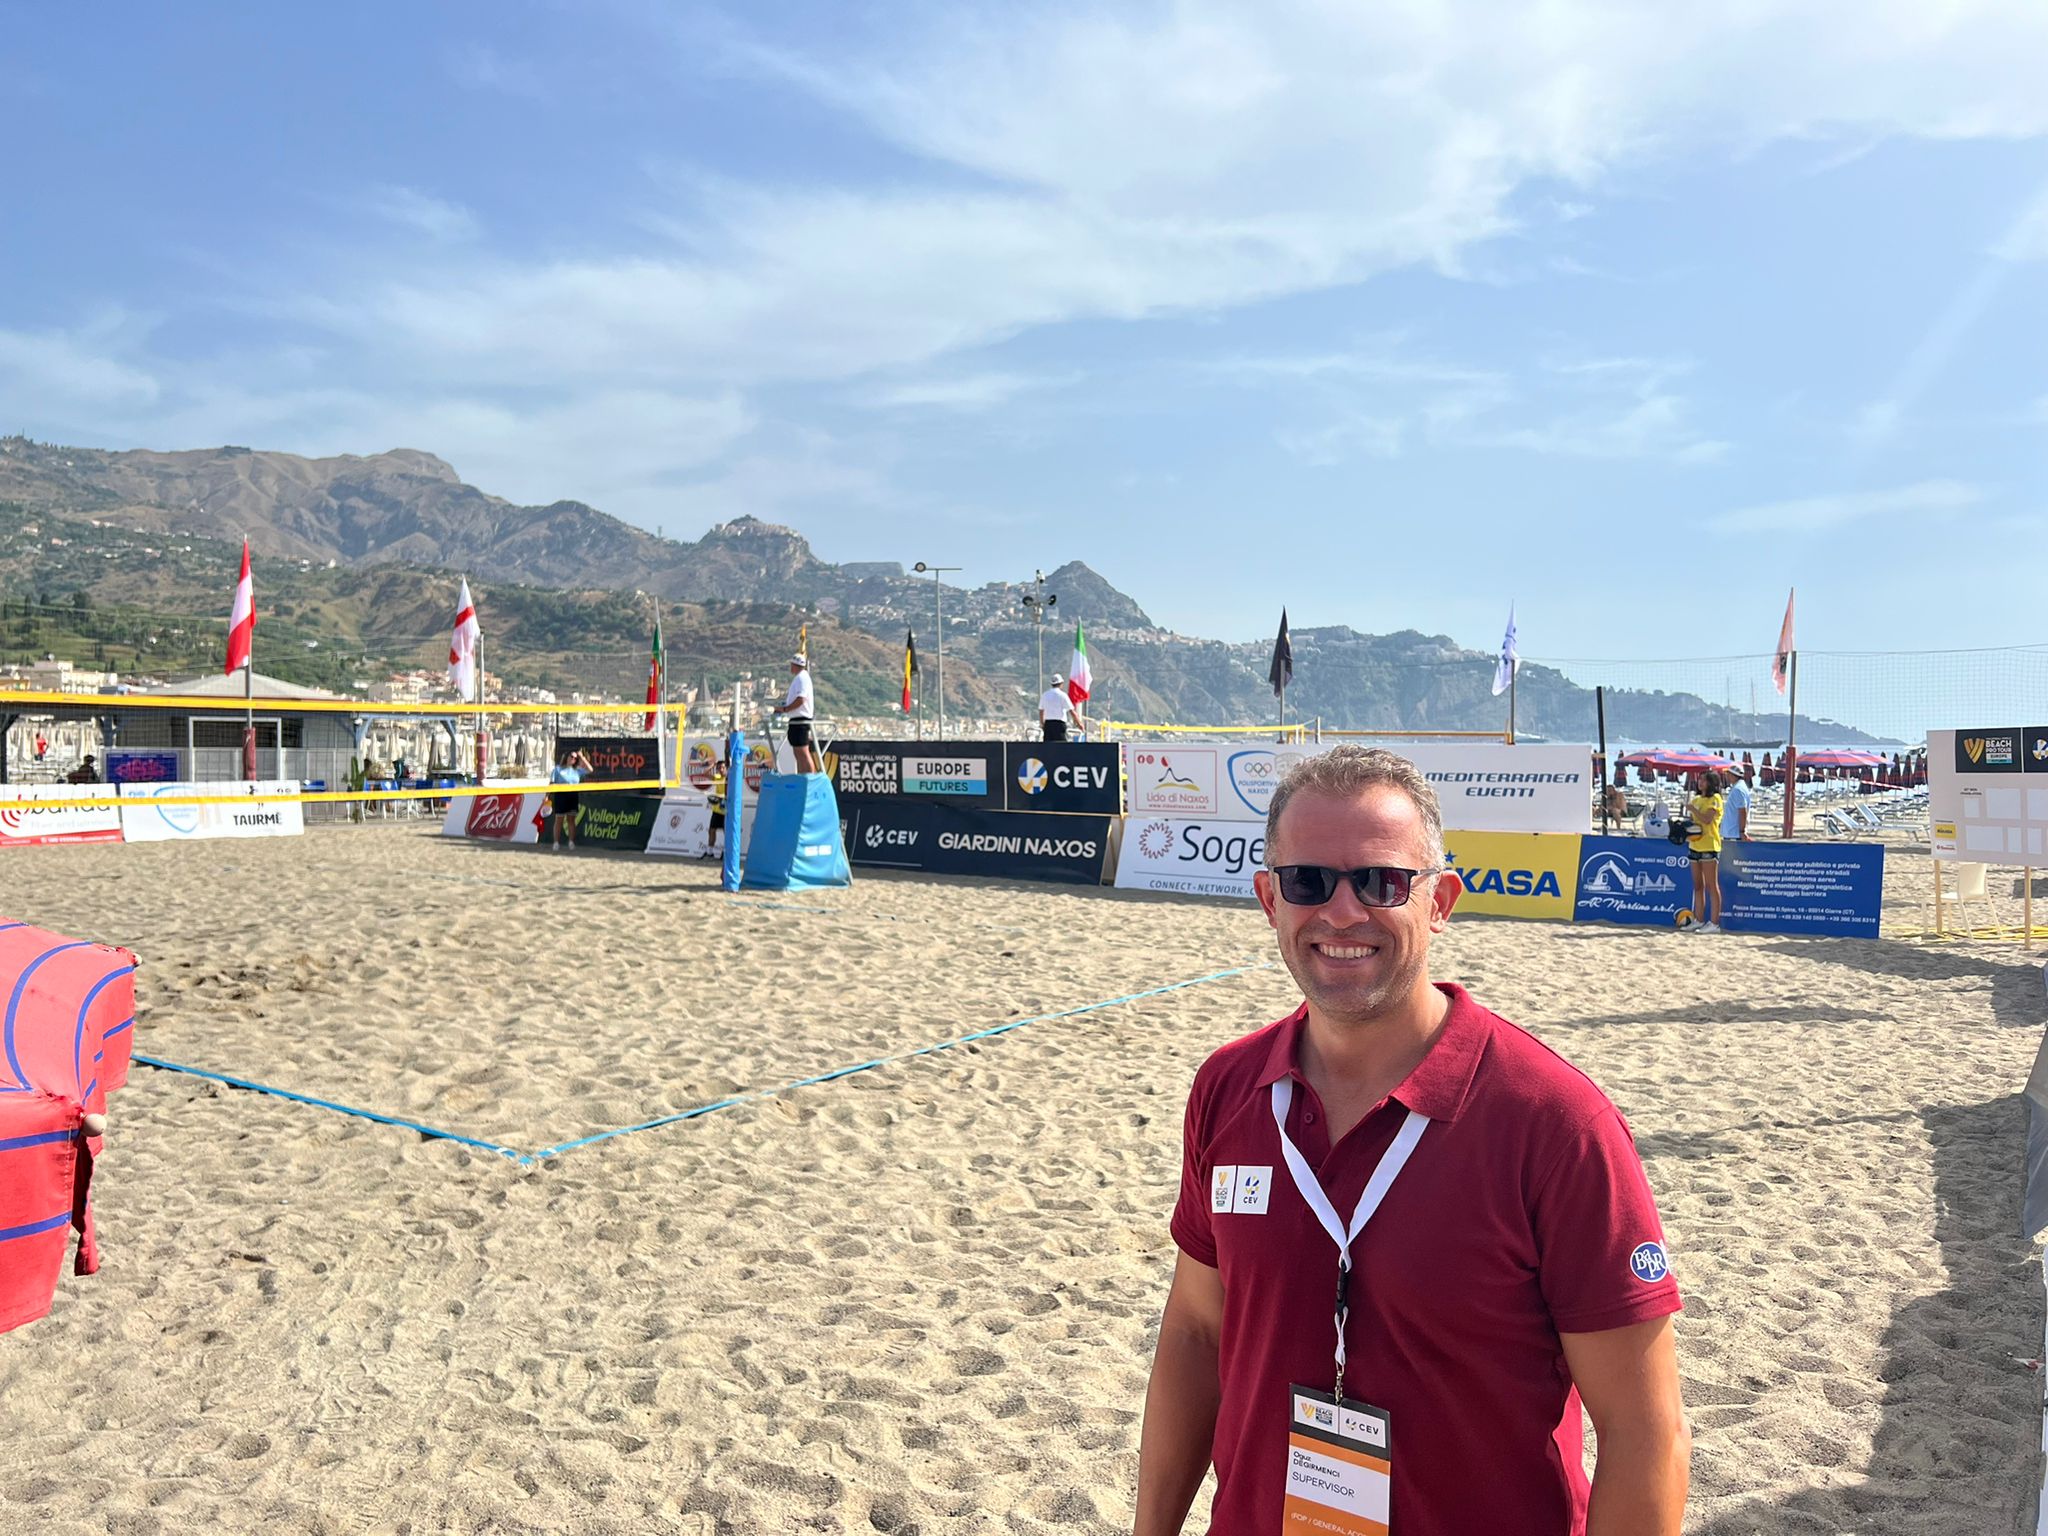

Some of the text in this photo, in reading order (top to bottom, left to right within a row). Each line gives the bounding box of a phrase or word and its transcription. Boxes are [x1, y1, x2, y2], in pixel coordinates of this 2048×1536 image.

[1985, 739, 2012, 748] BEACH
[591, 745, 645, 775] triptop
[840, 754, 876, 762] VOLLEYBALL
[839, 762, 898, 781] BEACH
[916, 762, 971, 776] EUROPE
[1053, 766, 1108, 789] CEV
[1425, 772, 1579, 783] MEDITERRANEA
[840, 780, 898, 794] PRO TOUR
[919, 781, 969, 792] FUTURES
[1146, 792, 1209, 804] Lido di Naxos
[588, 807, 641, 827] Volleyball
[584, 823, 620, 840] World
[886, 829, 918, 846] CEV
[938, 831, 1097, 859] GIARDINI NAXOS
[1733, 859, 1775, 868] Manutenzione
[1804, 861, 1832, 869] pubblico
[1742, 867, 1783, 875] Manutenzione
[1149, 879, 1192, 891] CONNECT
[1197, 883, 1244, 895] NETWORK
[1444, 867, 1562, 898] KASA
[1737, 881, 1769, 889] Montaggio
[1815, 884, 1853, 892] segnaletica
[1760, 889, 1800, 897] Monitoraggio
[1577, 896, 1602, 908] AR
[1243, 1196, 1258, 1204] CEV
[1358, 1423, 1379, 1435] CEV
[1293, 1458, 1340, 1478] DEGIRMENCI
[1292, 1471, 1355, 1498] SUPERVISOR
[1312, 1518, 1346, 1535] GENERAL
